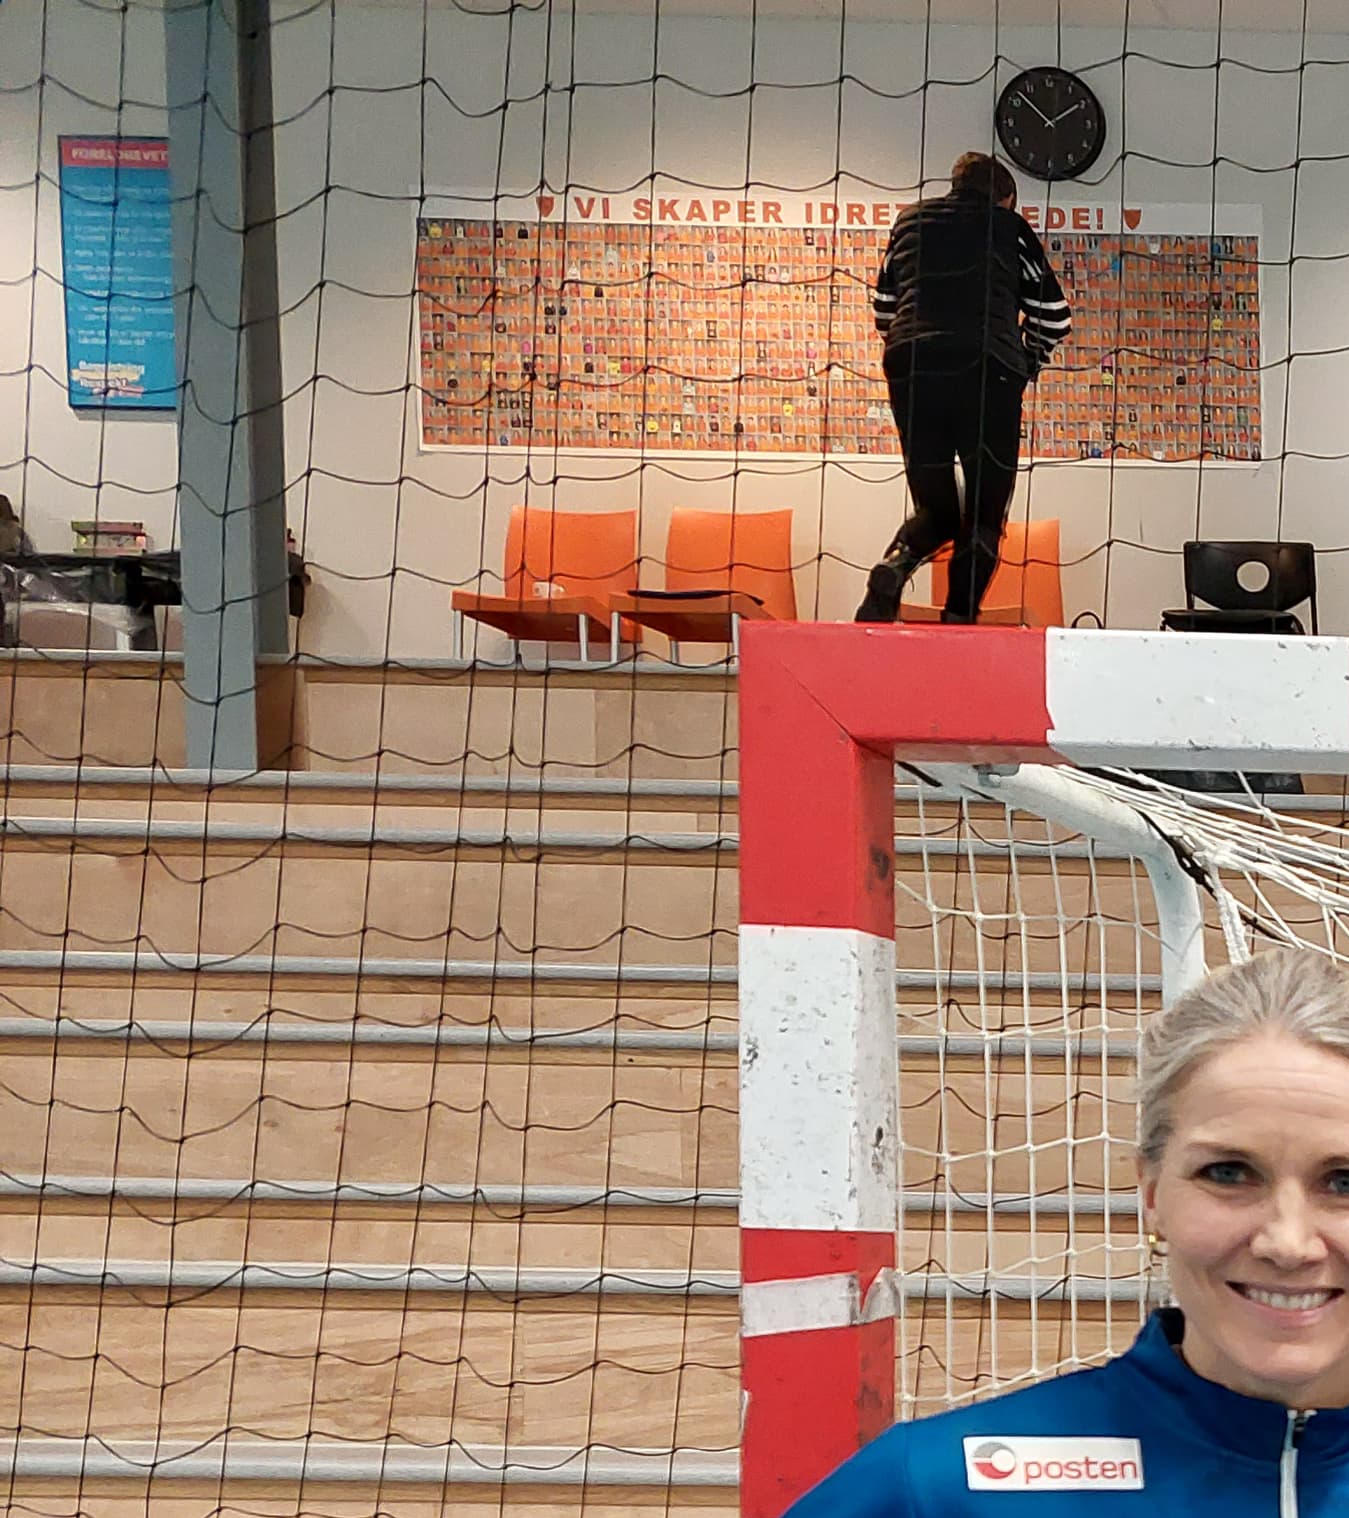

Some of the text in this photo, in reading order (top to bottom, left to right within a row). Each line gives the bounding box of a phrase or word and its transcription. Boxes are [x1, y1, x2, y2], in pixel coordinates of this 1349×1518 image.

[574, 197, 1104, 230] VI SKAPER IDREEDE!
[1024, 1458, 1138, 1484] posten
